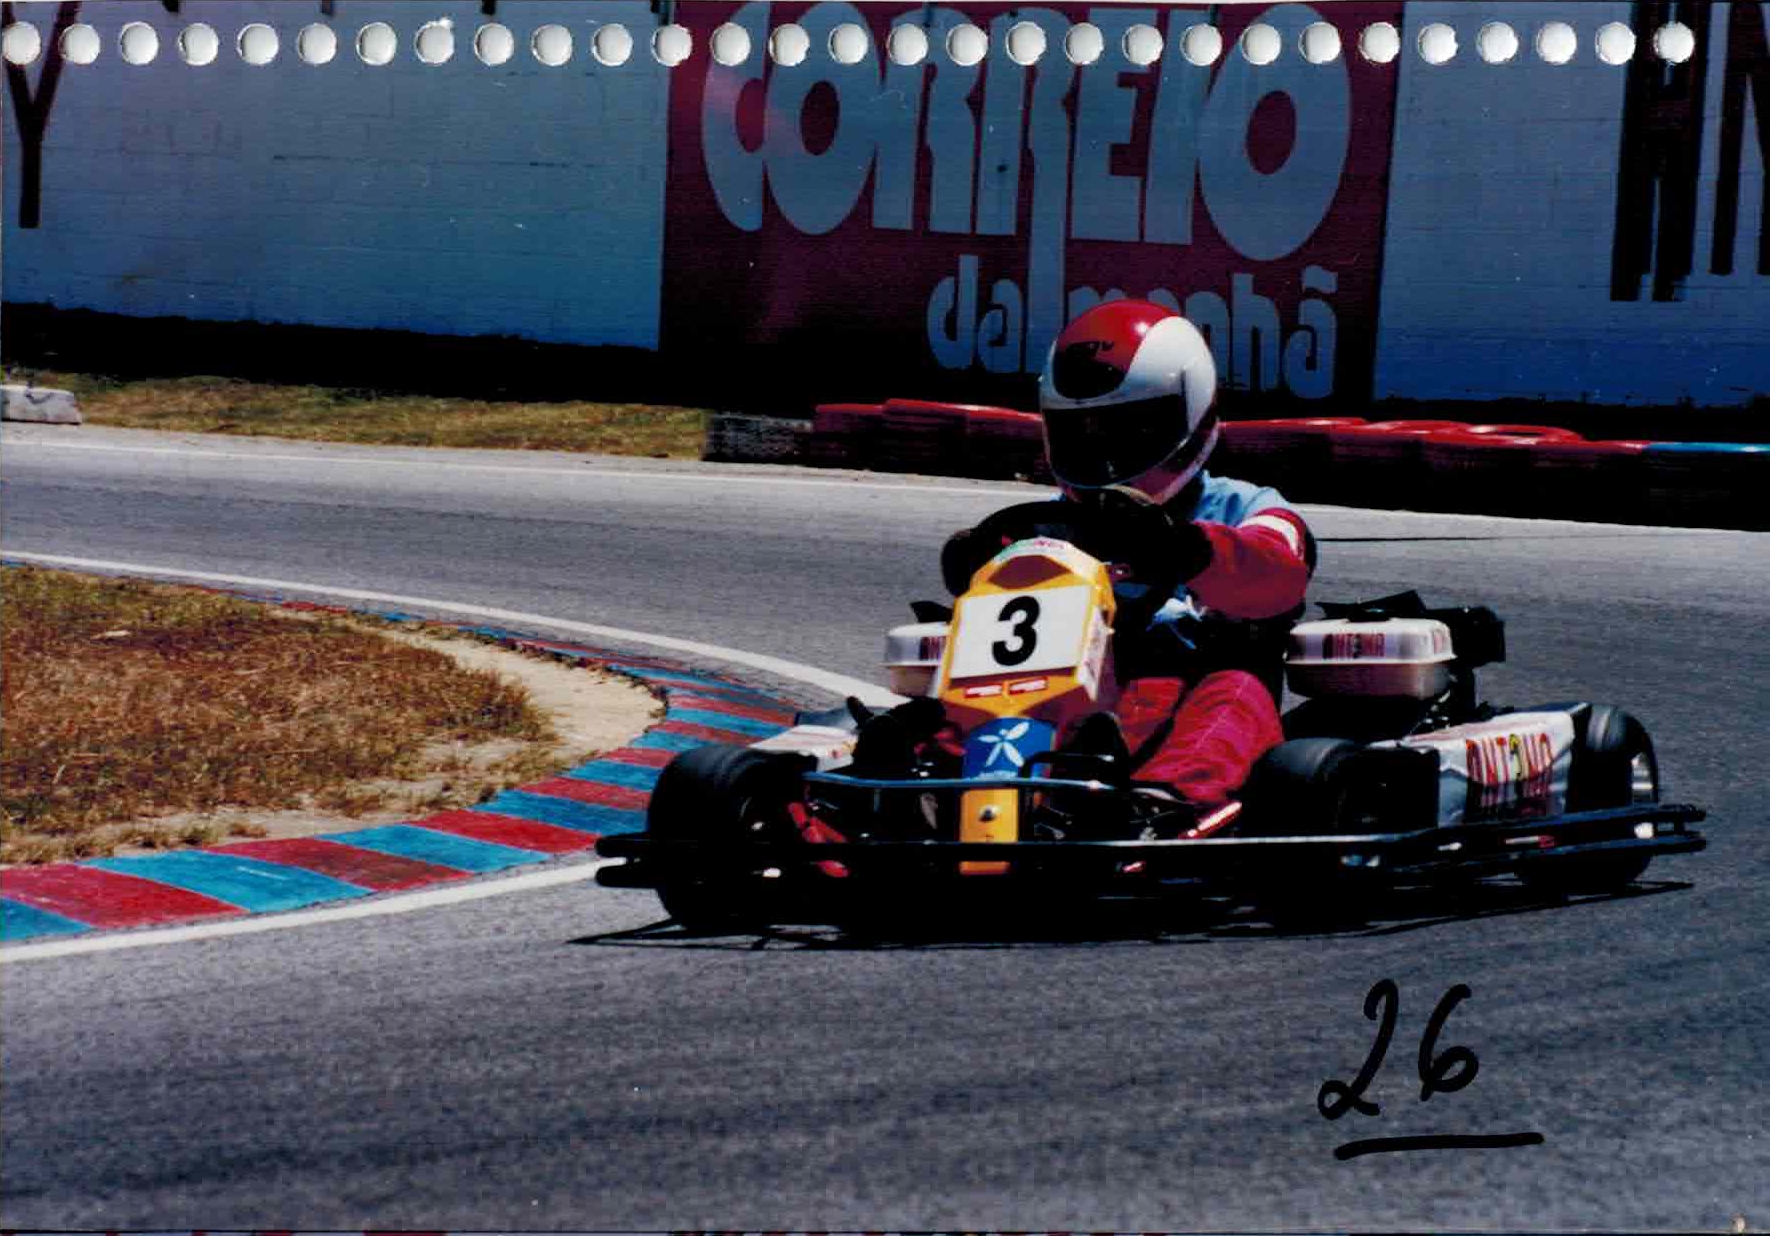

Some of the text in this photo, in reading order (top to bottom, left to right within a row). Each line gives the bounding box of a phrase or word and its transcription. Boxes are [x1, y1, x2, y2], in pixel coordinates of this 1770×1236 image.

[702, 2, 1352, 264] CORREIO
[926, 254, 1024, 374] da
[991, 595, 1041, 667] 3
[1317, 978, 1479, 1120] 26
